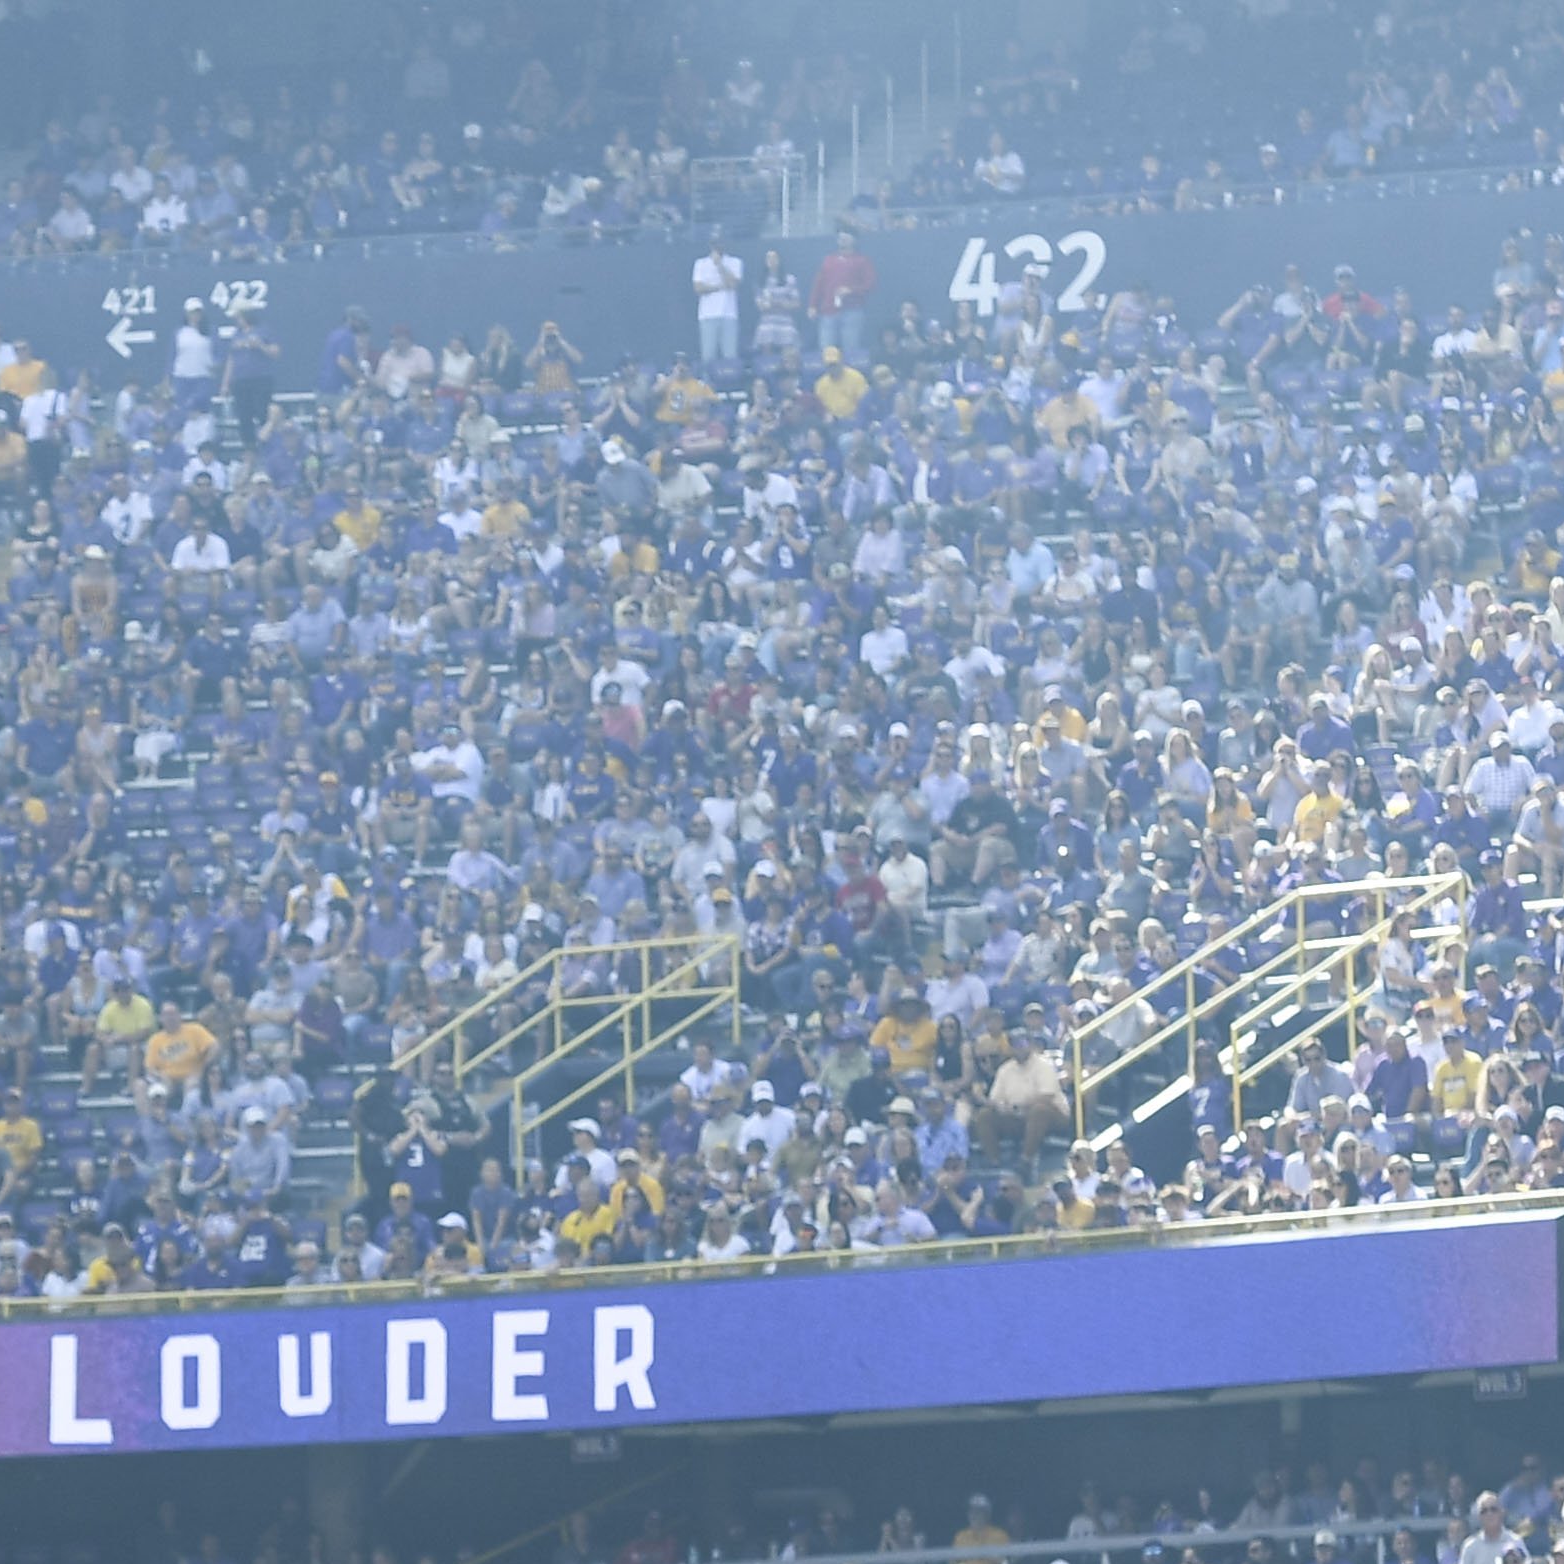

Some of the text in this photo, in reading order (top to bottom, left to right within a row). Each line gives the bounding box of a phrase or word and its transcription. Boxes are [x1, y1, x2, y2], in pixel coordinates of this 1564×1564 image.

[103, 285, 156, 316] 421
[407, 1143, 425, 1168] 3
[48, 1303, 656, 1446] LOUDER
